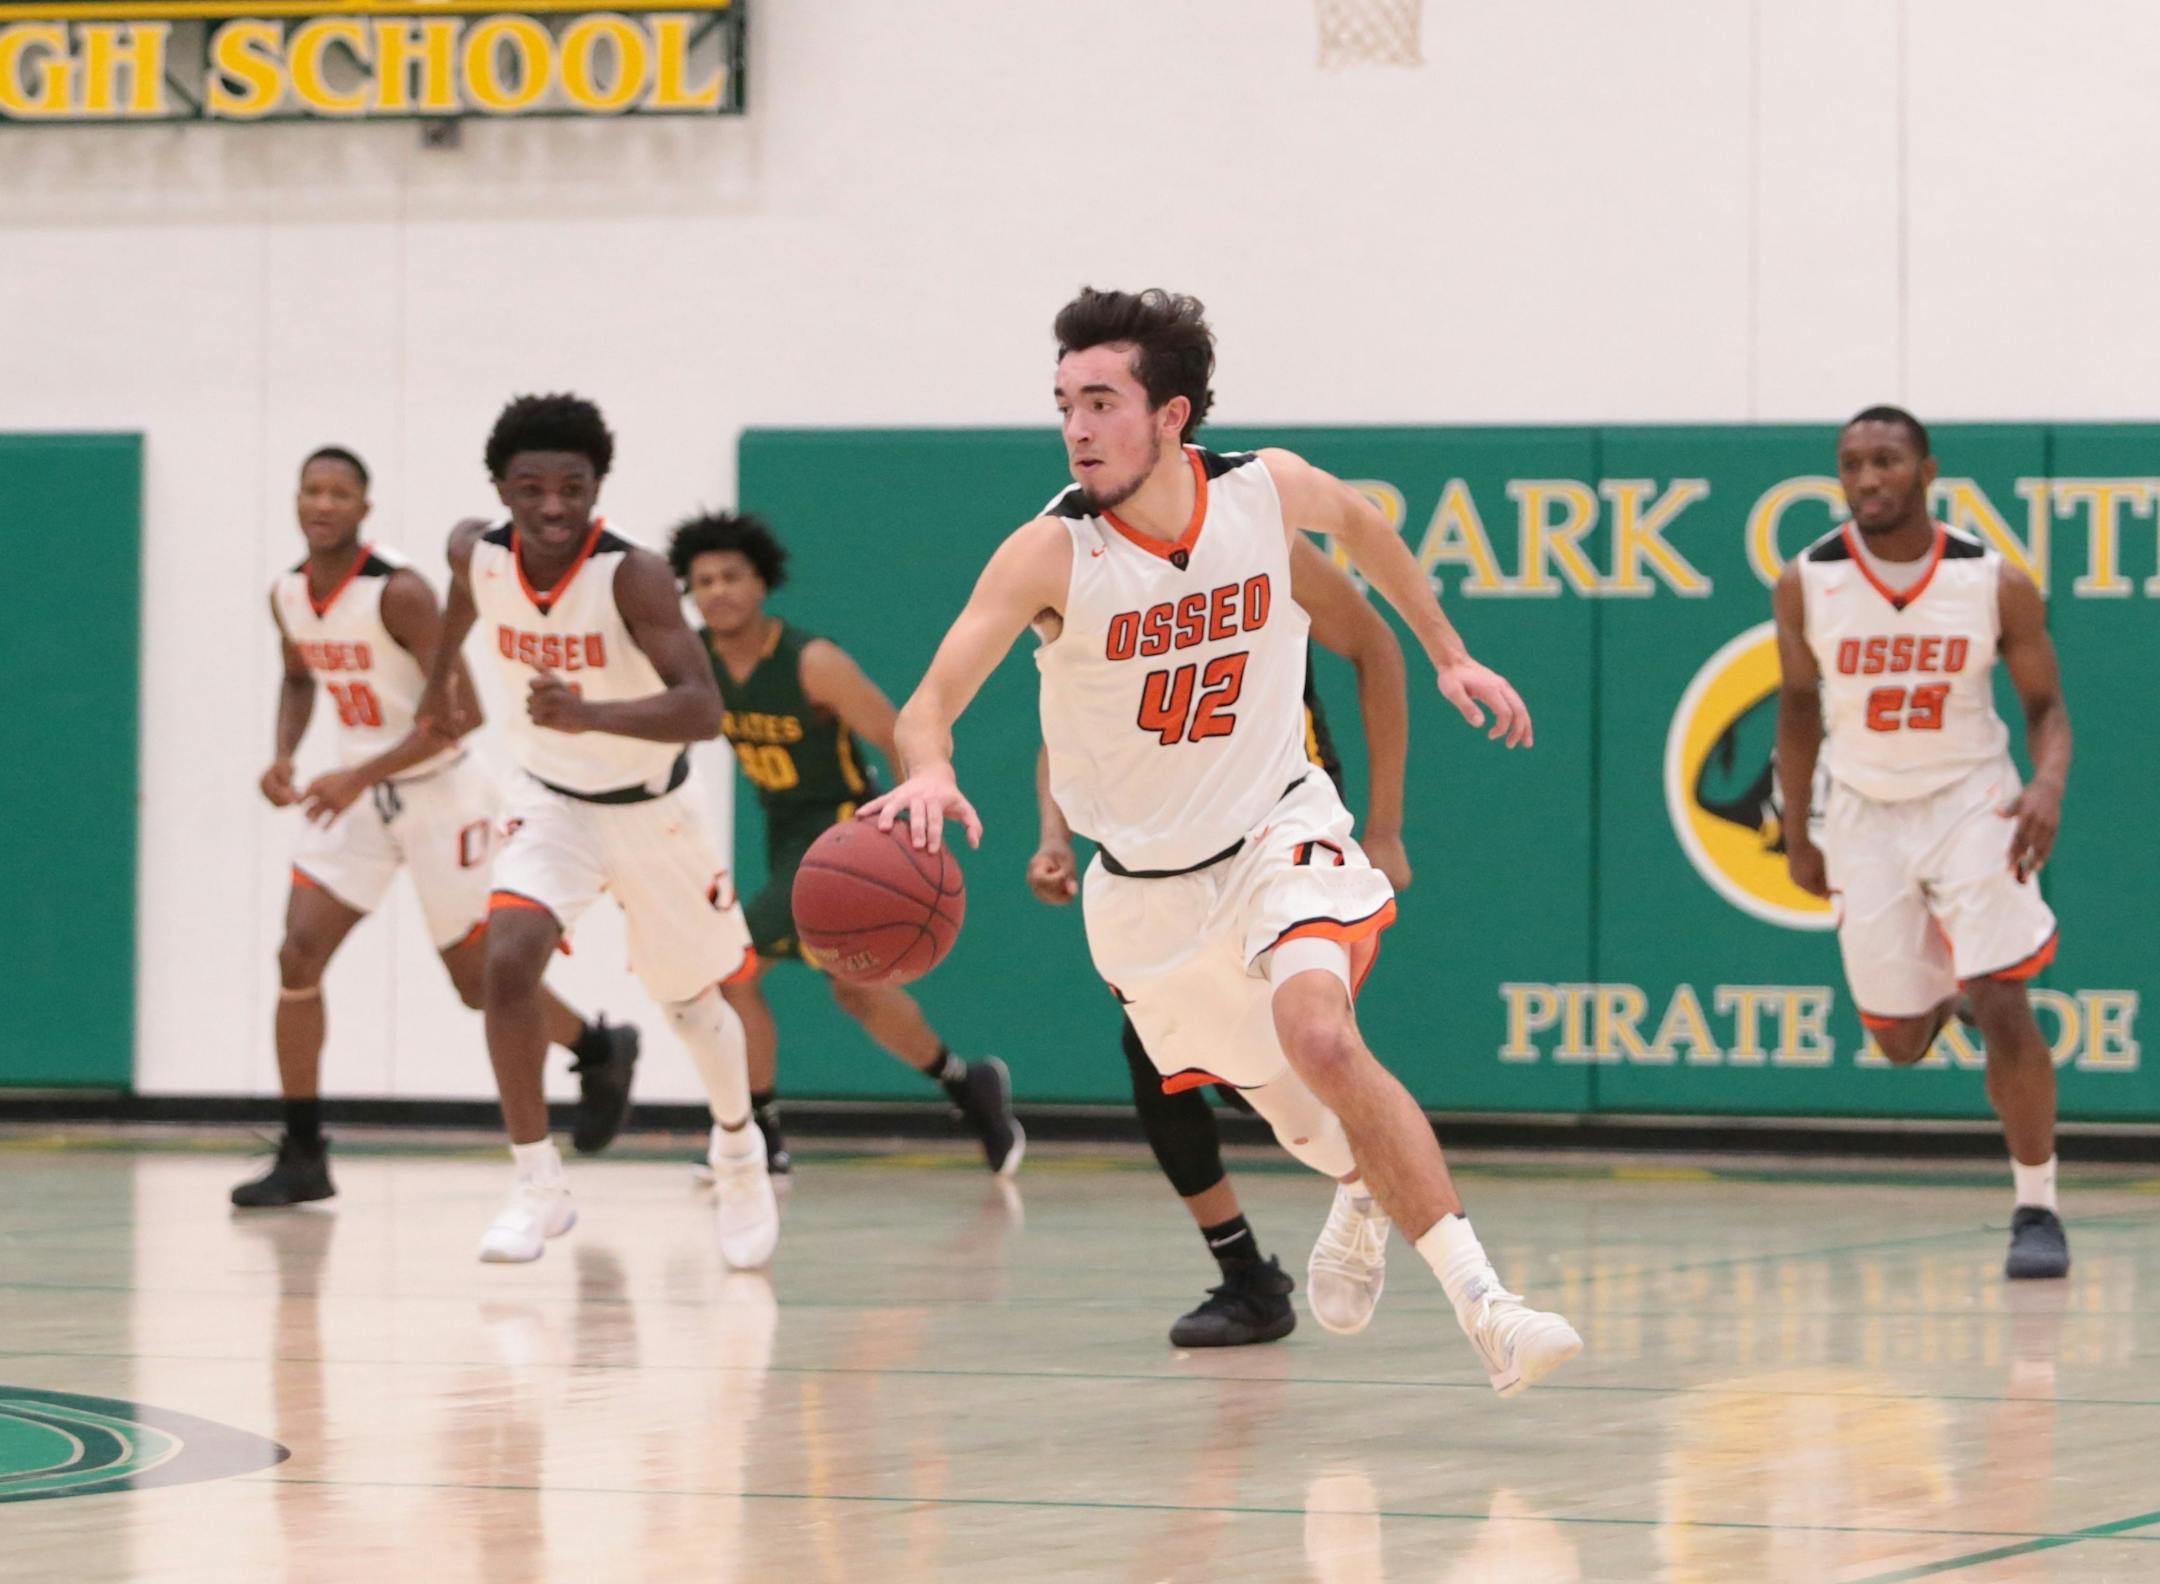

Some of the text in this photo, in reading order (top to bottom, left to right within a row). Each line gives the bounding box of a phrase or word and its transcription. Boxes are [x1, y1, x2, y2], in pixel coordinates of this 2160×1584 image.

[205, 12, 730, 119] SCHOOL
[1137, 651, 1249, 746] 42
[1499, 982, 1835, 1067] PIRATE
